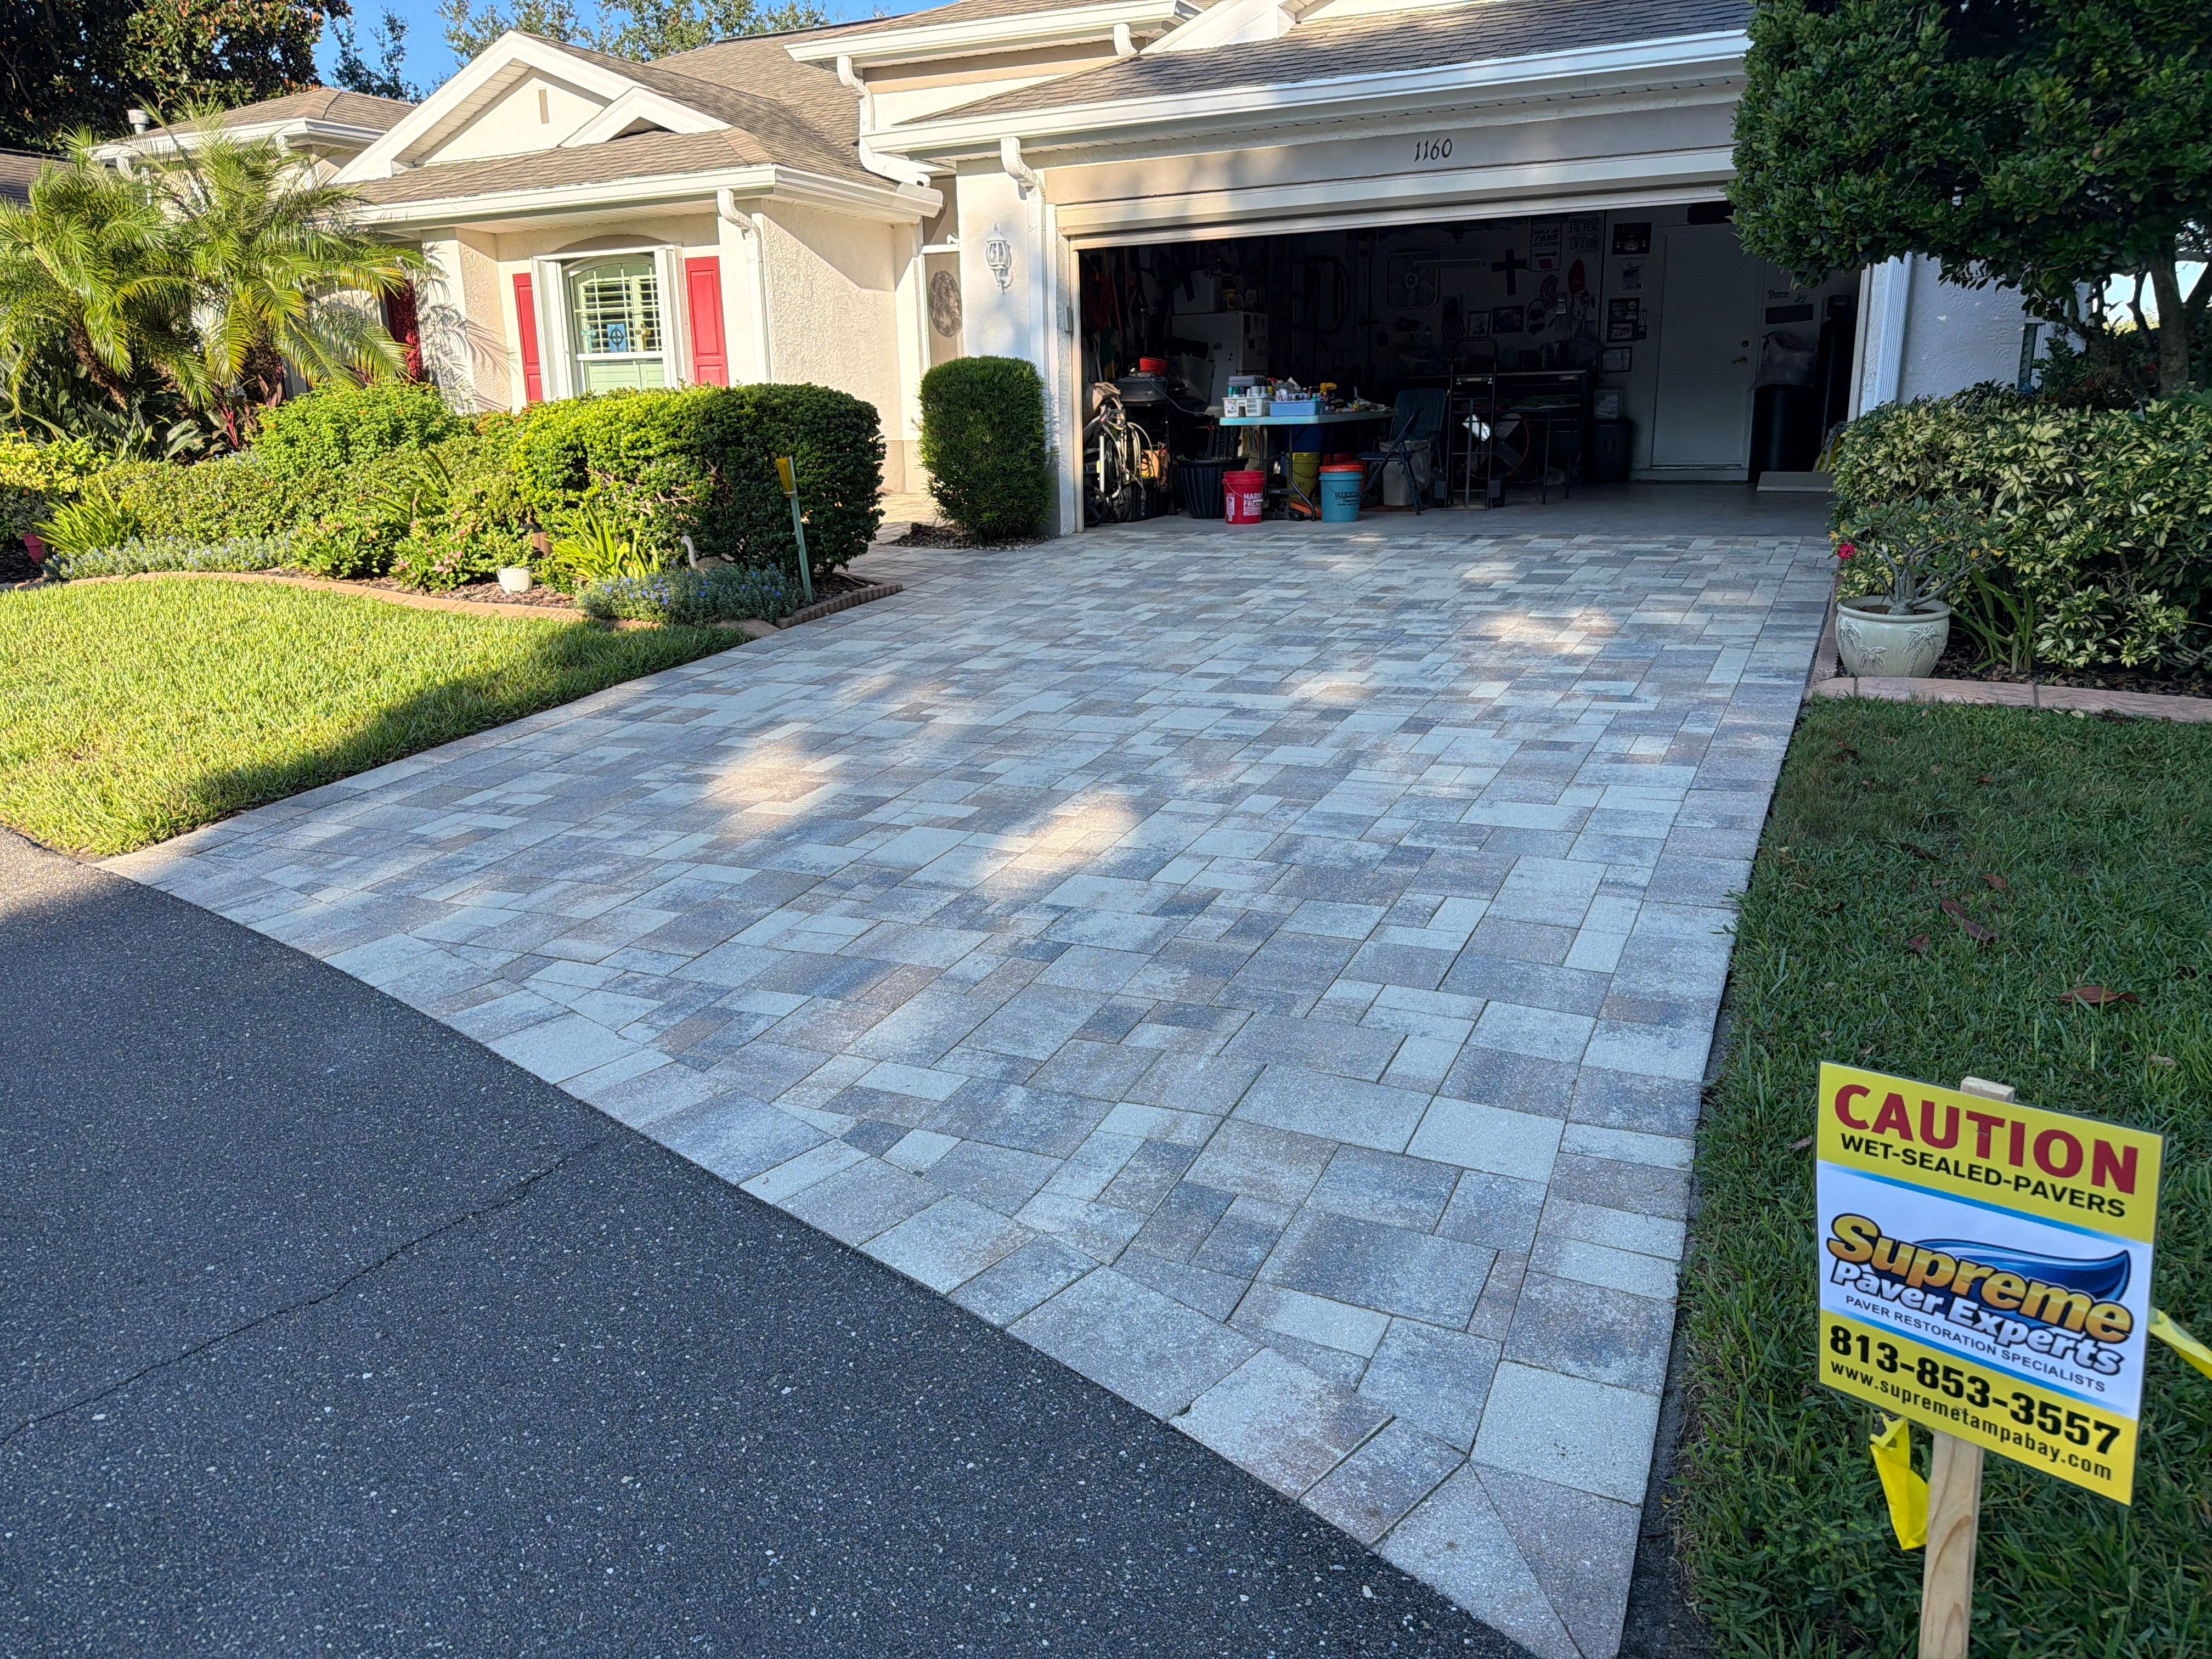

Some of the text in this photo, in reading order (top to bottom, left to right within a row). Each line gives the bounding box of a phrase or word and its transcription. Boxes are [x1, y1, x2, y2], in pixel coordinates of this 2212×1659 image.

[1414, 138, 1453, 162] 1160
[1835, 1084, 2138, 1195] CAUTION
[1841, 1133, 2125, 1217] WET-SEALED-PAVERS
[1826, 1212, 2134, 1344] Supreme
[1830, 1259, 2125, 1376] Paver Experts
[1830, 1325, 2120, 1455] 813-853-3557
[1846, 1295, 2106, 1392] PAVER RESTORATION SPECIALISTS
[1831, 1361, 2111, 1481] www.supremetampabay.com
